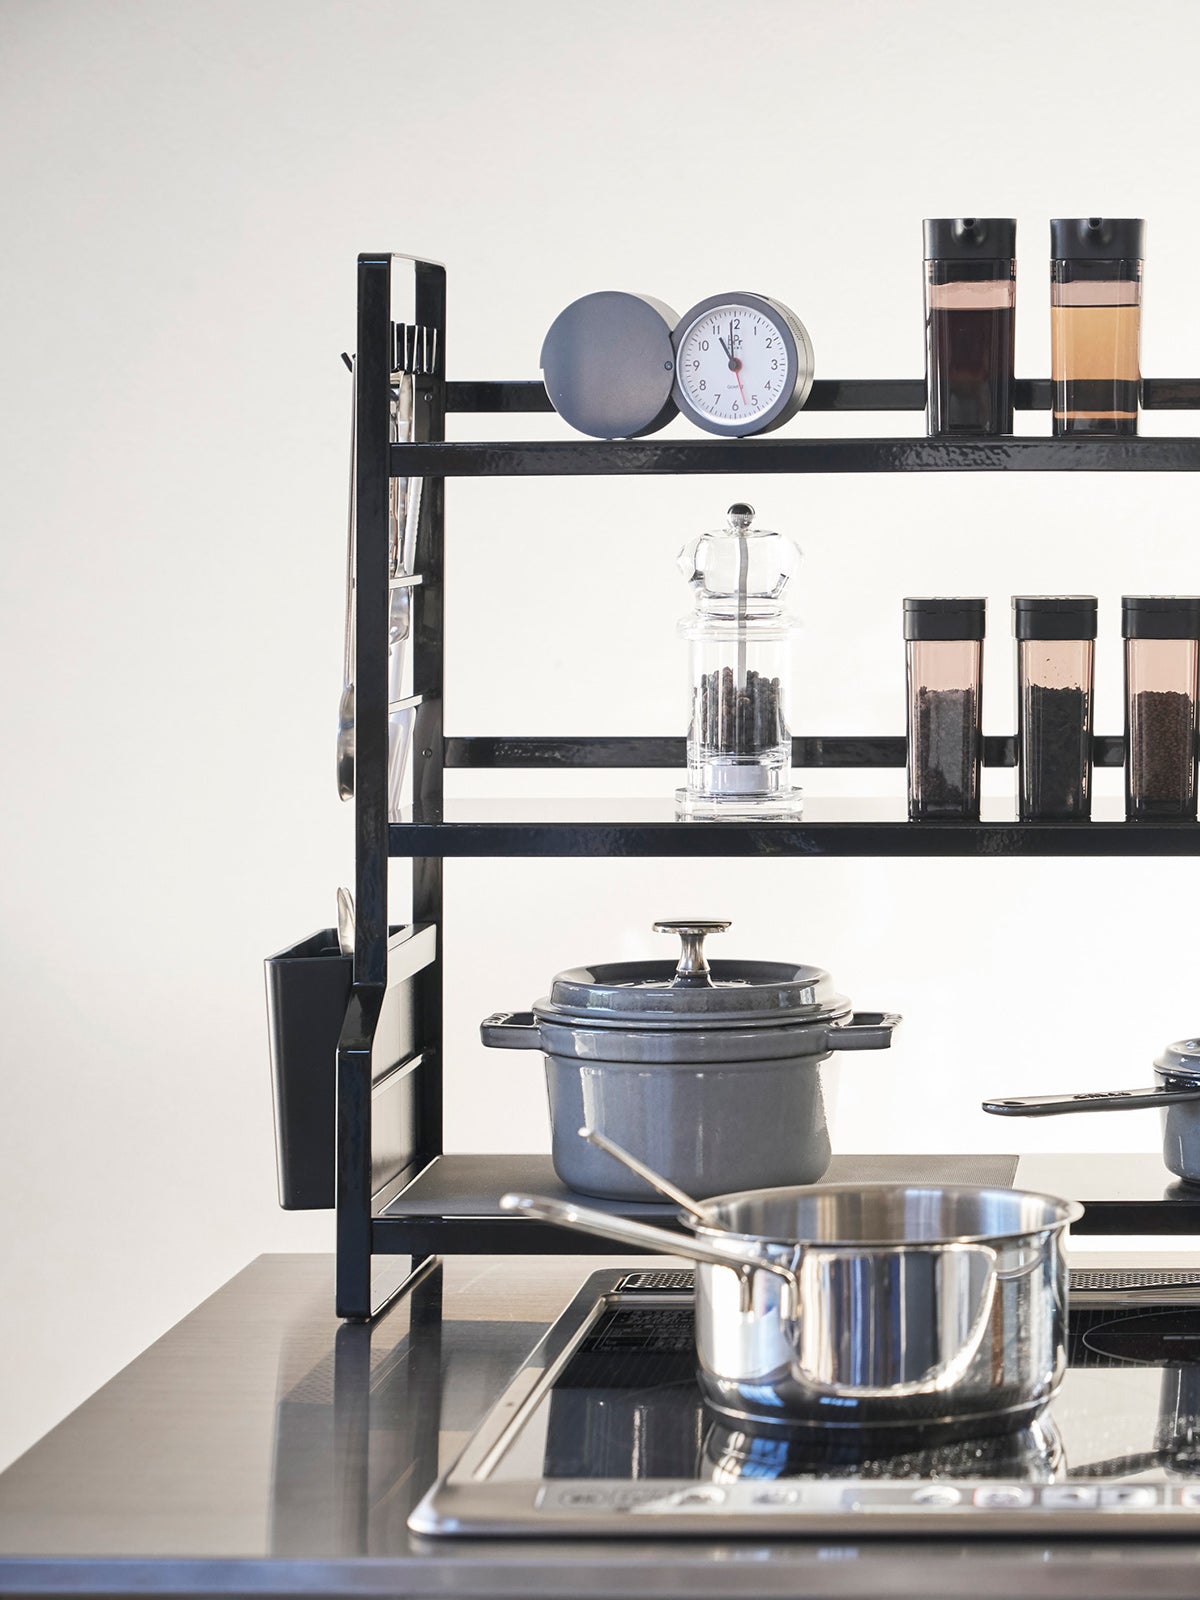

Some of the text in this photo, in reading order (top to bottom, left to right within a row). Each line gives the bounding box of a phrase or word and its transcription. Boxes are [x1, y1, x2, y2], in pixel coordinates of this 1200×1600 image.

[713, 325, 720, 335] 11
[730, 319, 740, 330] 2
[698, 340, 709, 351] 10
[765, 337, 773, 349] 2
[693, 360, 700, 371] 9
[771, 359, 778, 370] 3
[699, 379, 707, 391] 8
[764, 380, 771, 391] 4
[714, 394, 721, 405] 7
[751, 395, 758, 406] 5
[732, 400, 739, 412] 6
